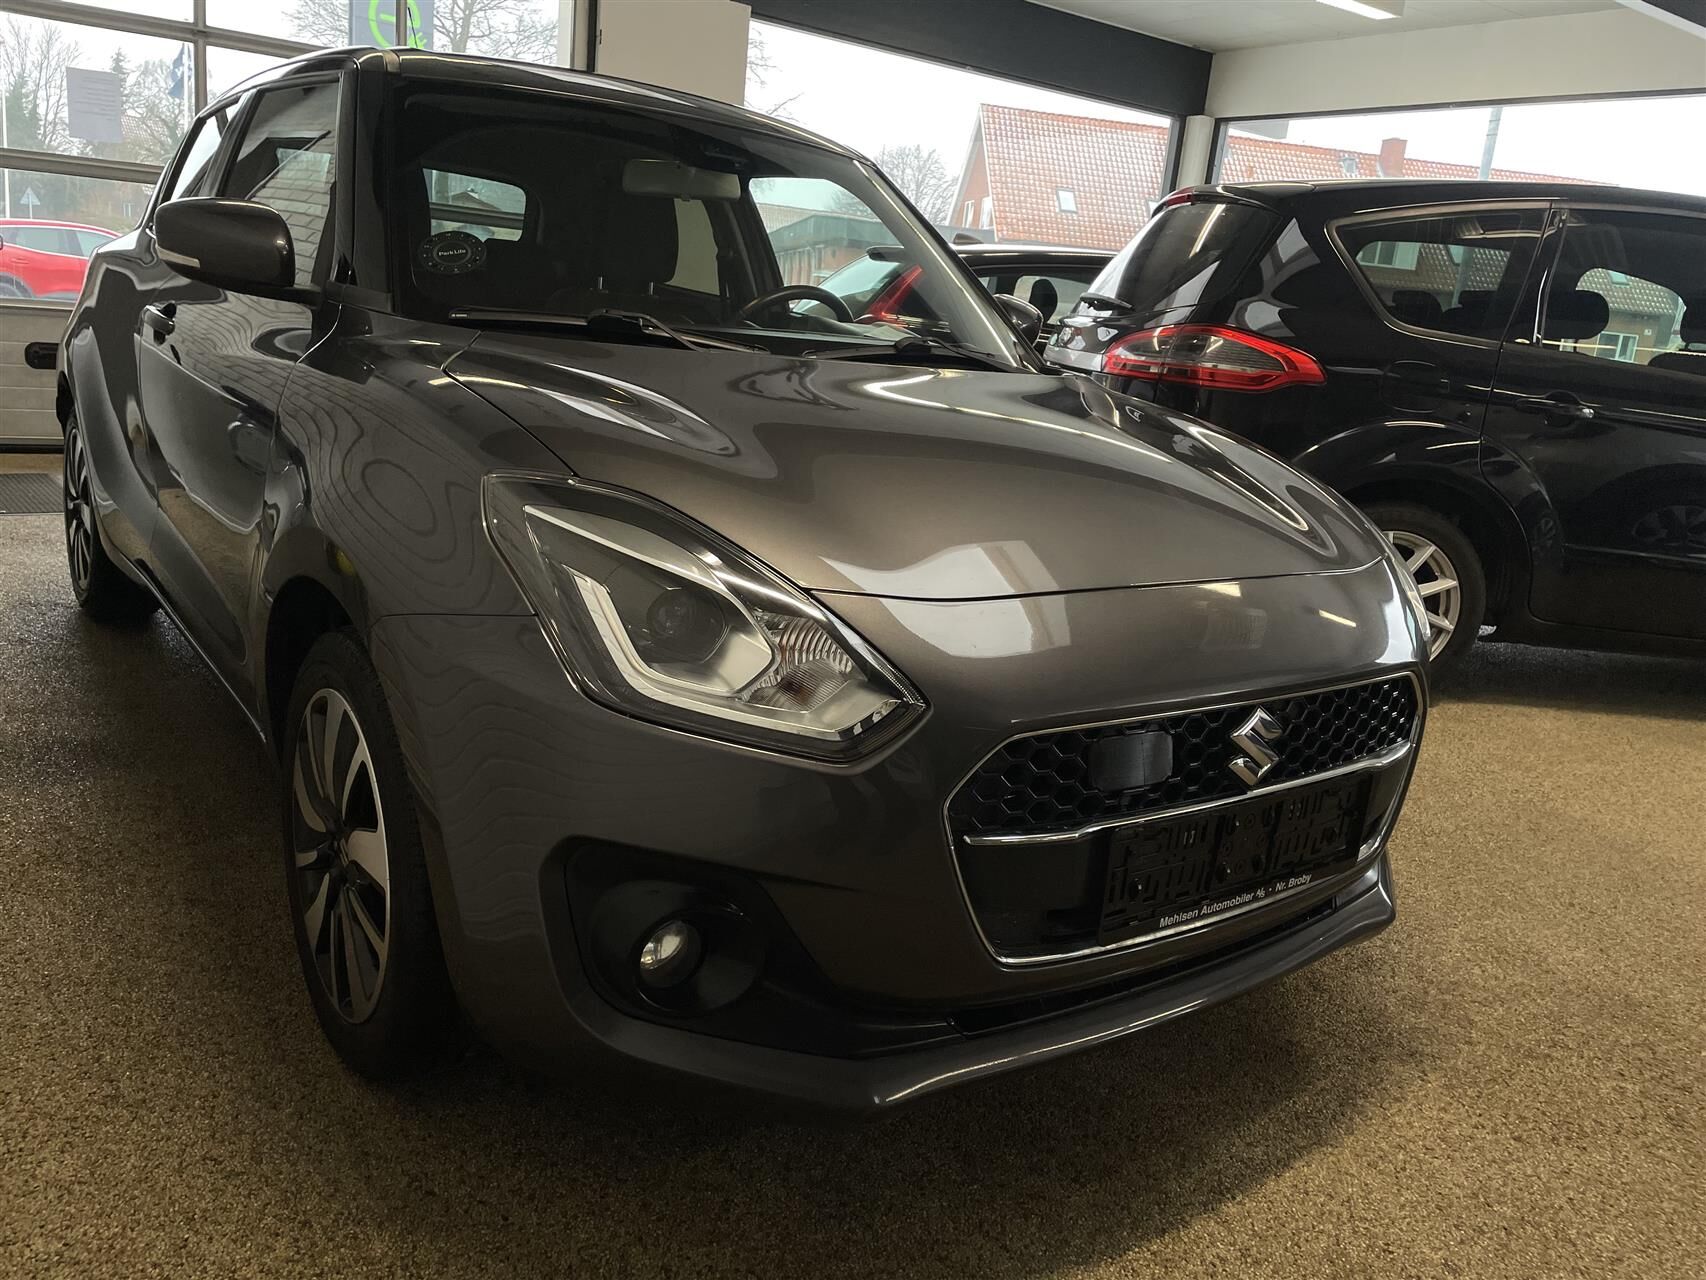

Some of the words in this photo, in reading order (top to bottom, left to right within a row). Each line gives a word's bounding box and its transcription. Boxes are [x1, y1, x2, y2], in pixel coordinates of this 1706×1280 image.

[1159, 909, 1199, 928] Mehlsen
[1200, 892, 1254, 916] Automobiler
[1275, 882, 1287, 893] Nr.
[1288, 873, 1312, 888] Broby
